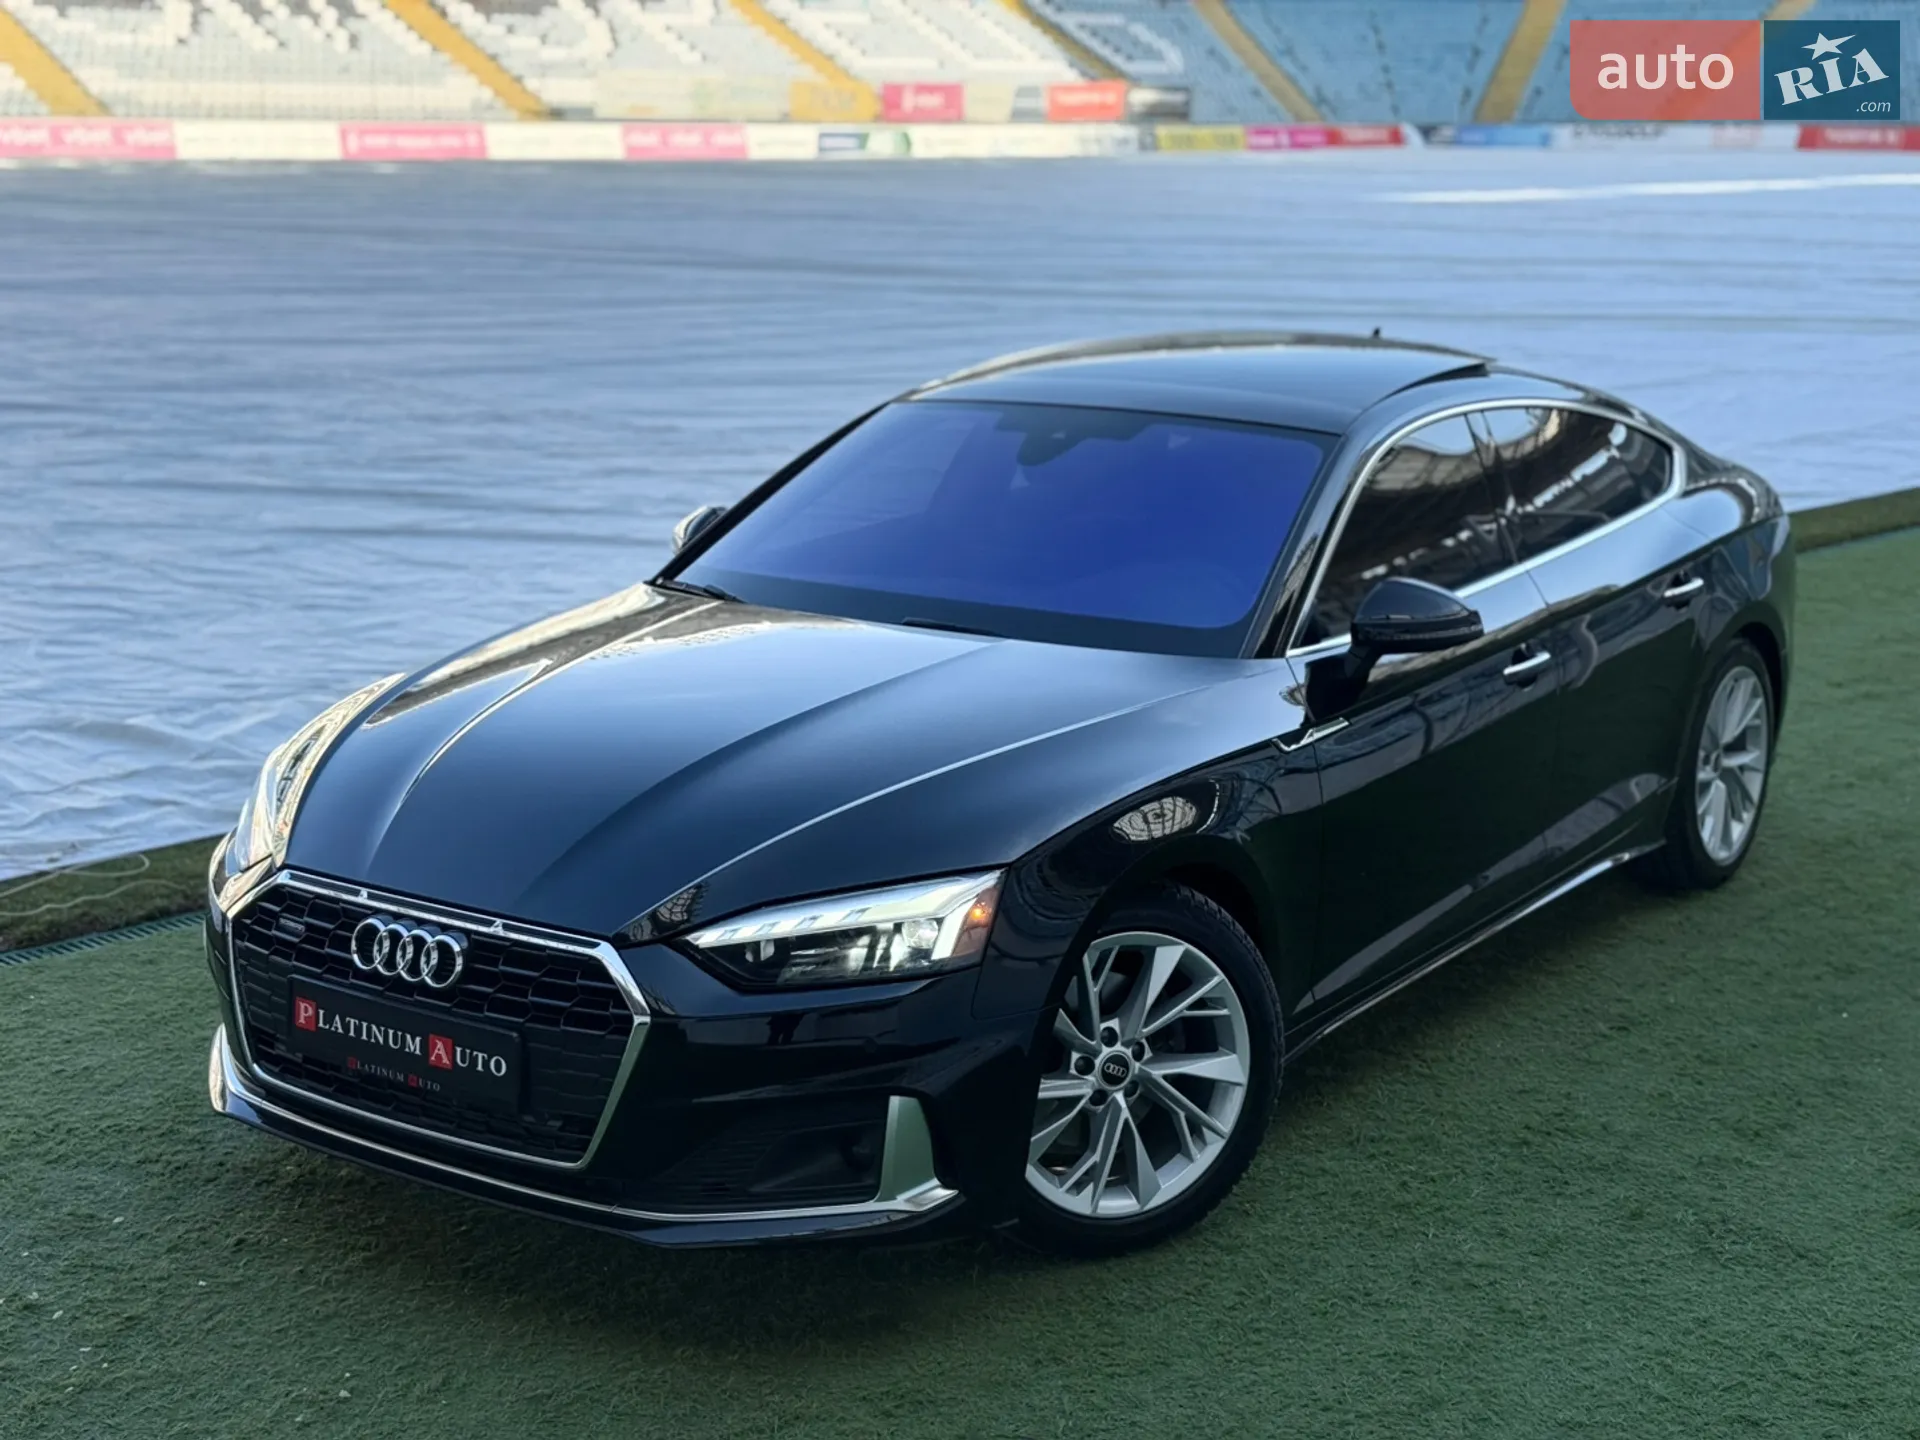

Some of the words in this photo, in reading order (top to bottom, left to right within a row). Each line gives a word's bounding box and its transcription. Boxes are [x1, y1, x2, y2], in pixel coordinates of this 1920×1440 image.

[297, 999, 422, 1056] PLATINUM
[430, 1037, 507, 1077] AUTO
[347, 1057, 404, 1082] LATINUM
[408, 1074, 441, 1092] UTO
